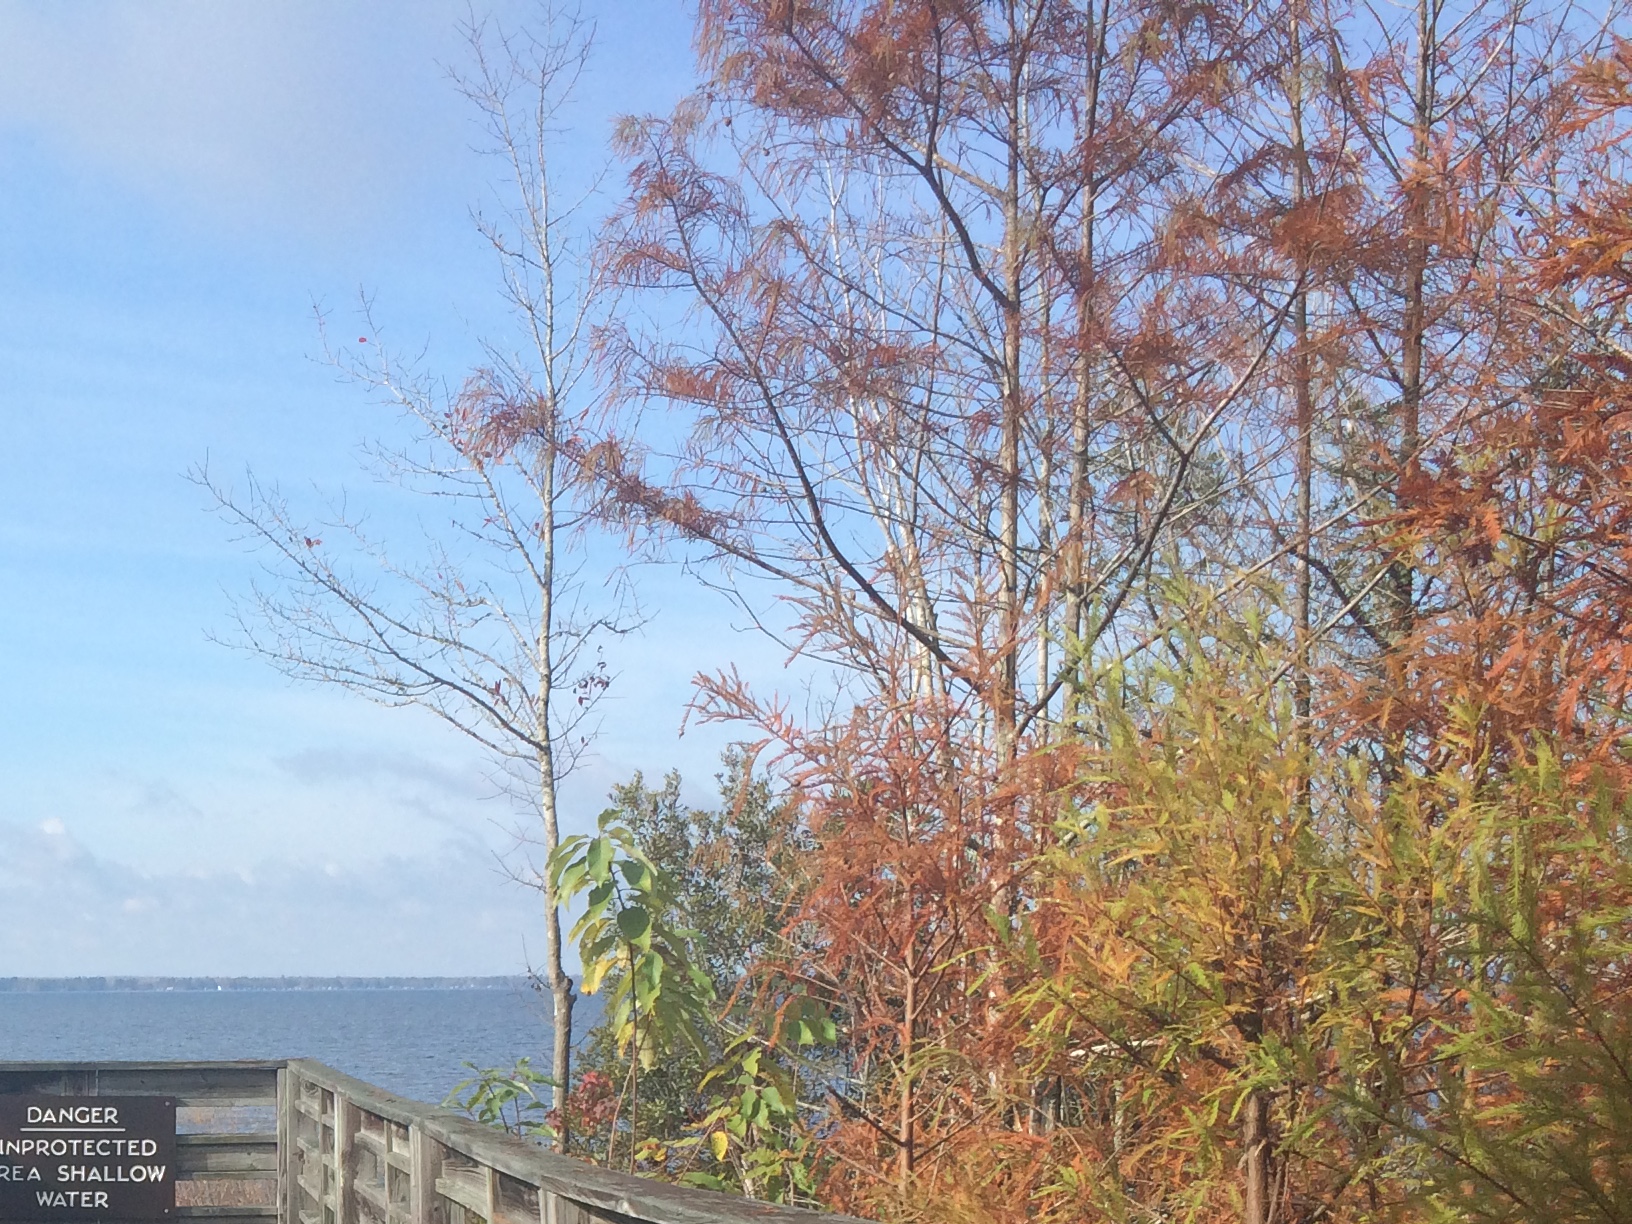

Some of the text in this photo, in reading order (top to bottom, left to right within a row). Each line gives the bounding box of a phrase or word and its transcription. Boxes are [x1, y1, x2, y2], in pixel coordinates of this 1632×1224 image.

[27, 1106, 118, 1124] DANGER
[57, 1165, 166, 1183] SHALLOW
[36, 1191, 109, 1208] WATER
